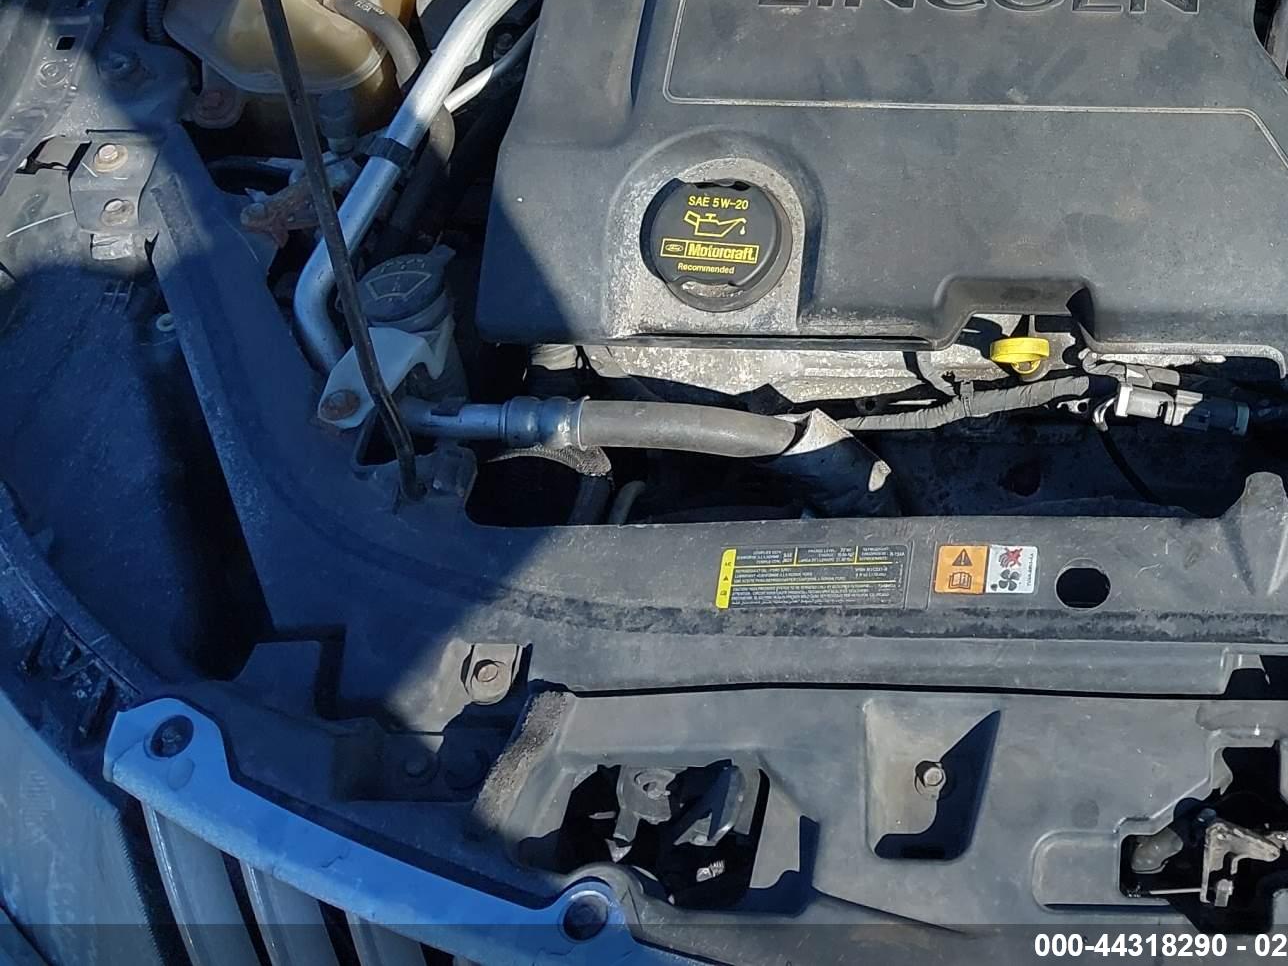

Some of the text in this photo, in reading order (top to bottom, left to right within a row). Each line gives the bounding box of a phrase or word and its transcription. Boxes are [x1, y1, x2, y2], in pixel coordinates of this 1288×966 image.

[687, 195, 749, 211] SAE 5W-20
[677, 262, 734, 274] Recommended
